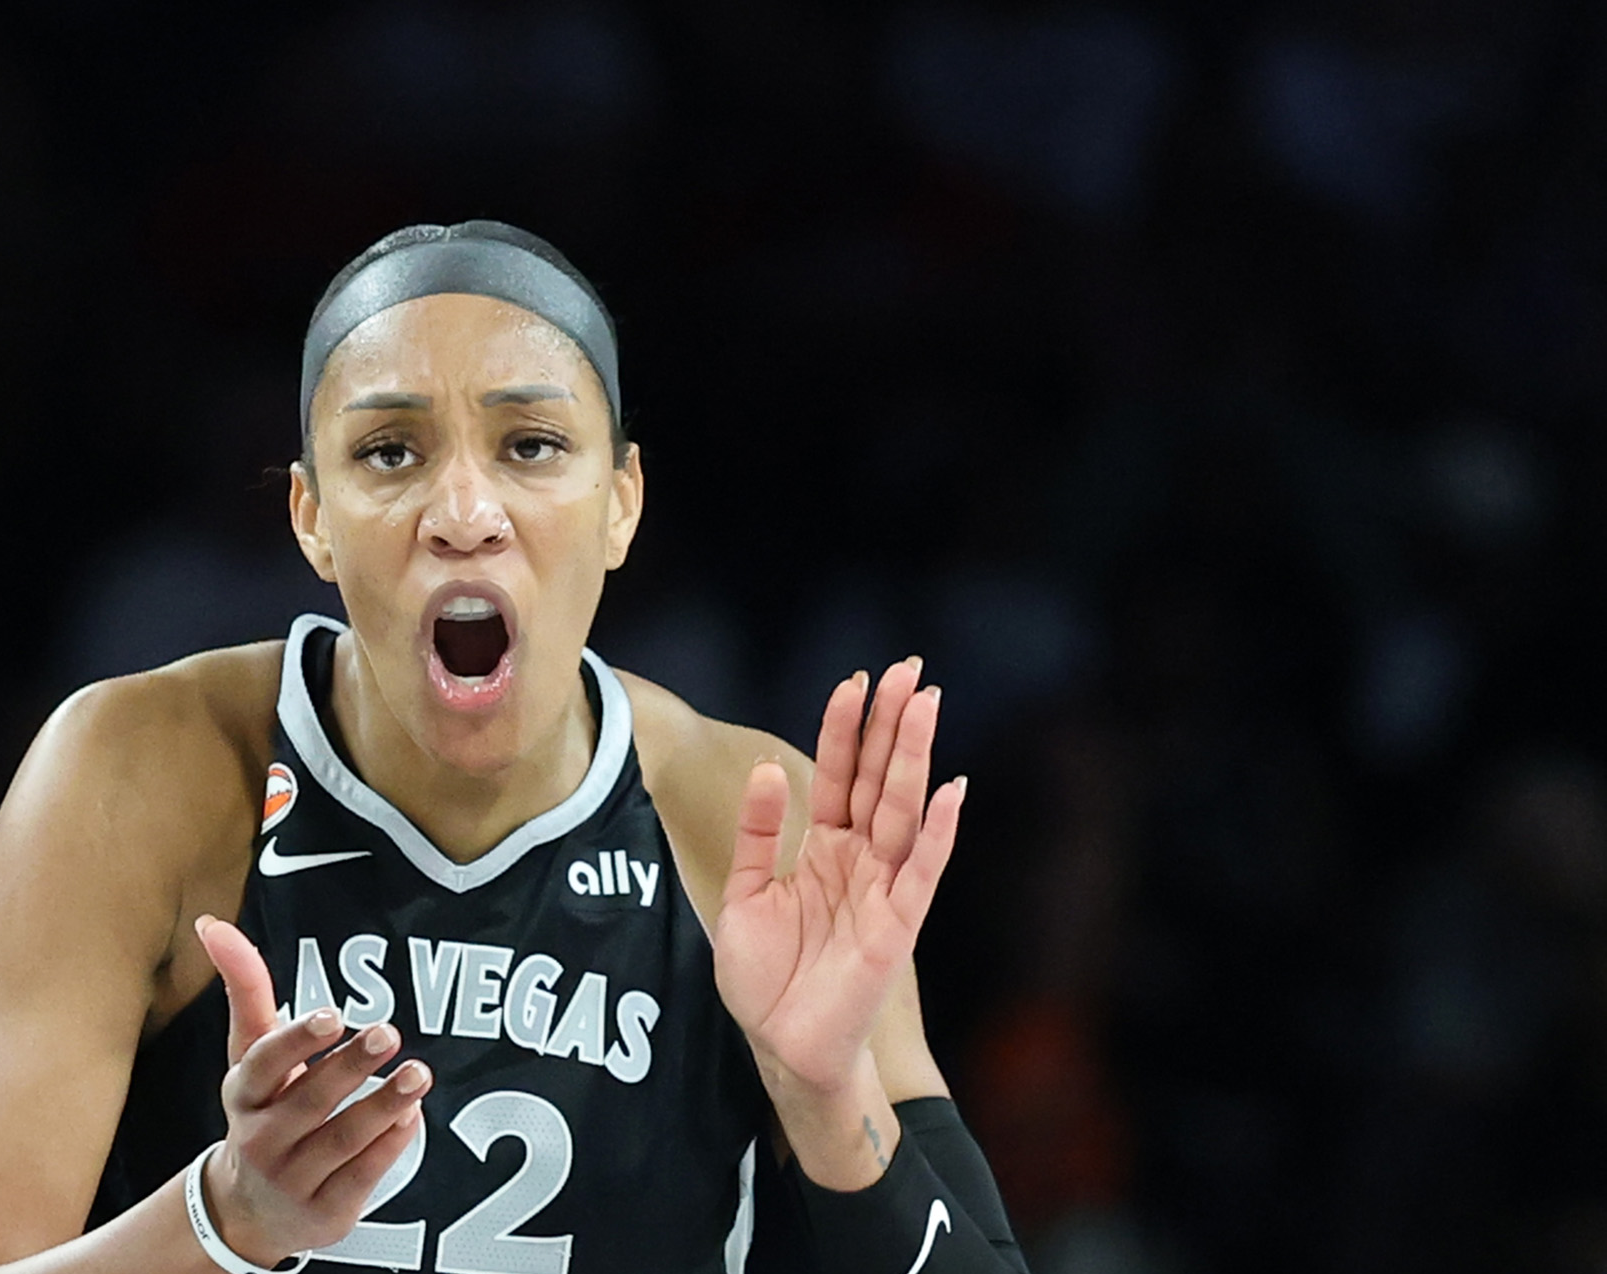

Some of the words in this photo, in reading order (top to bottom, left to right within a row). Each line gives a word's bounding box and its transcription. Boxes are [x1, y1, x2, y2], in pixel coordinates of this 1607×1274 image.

[567, 849, 660, 907] ally
[277, 933, 395, 1030] AS
[407, 936, 661, 1084] VEGAS
